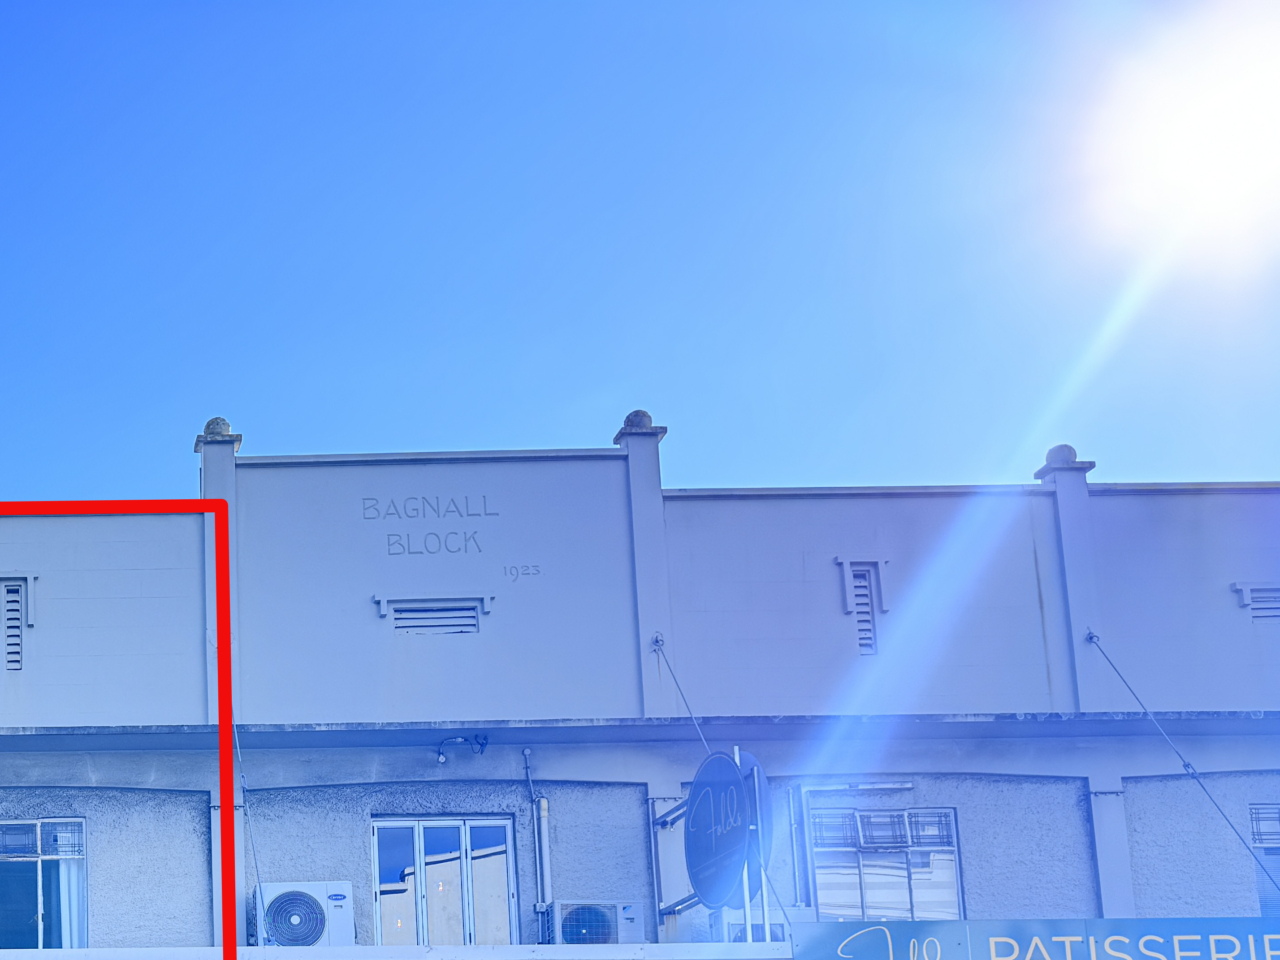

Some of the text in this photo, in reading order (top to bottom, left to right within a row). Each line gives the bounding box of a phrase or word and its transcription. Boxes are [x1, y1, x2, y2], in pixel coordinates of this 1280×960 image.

[362, 495, 499, 520] BAGNALL
[387, 530, 482, 556] BLOCK
[689, 785, 744, 852] Folds
